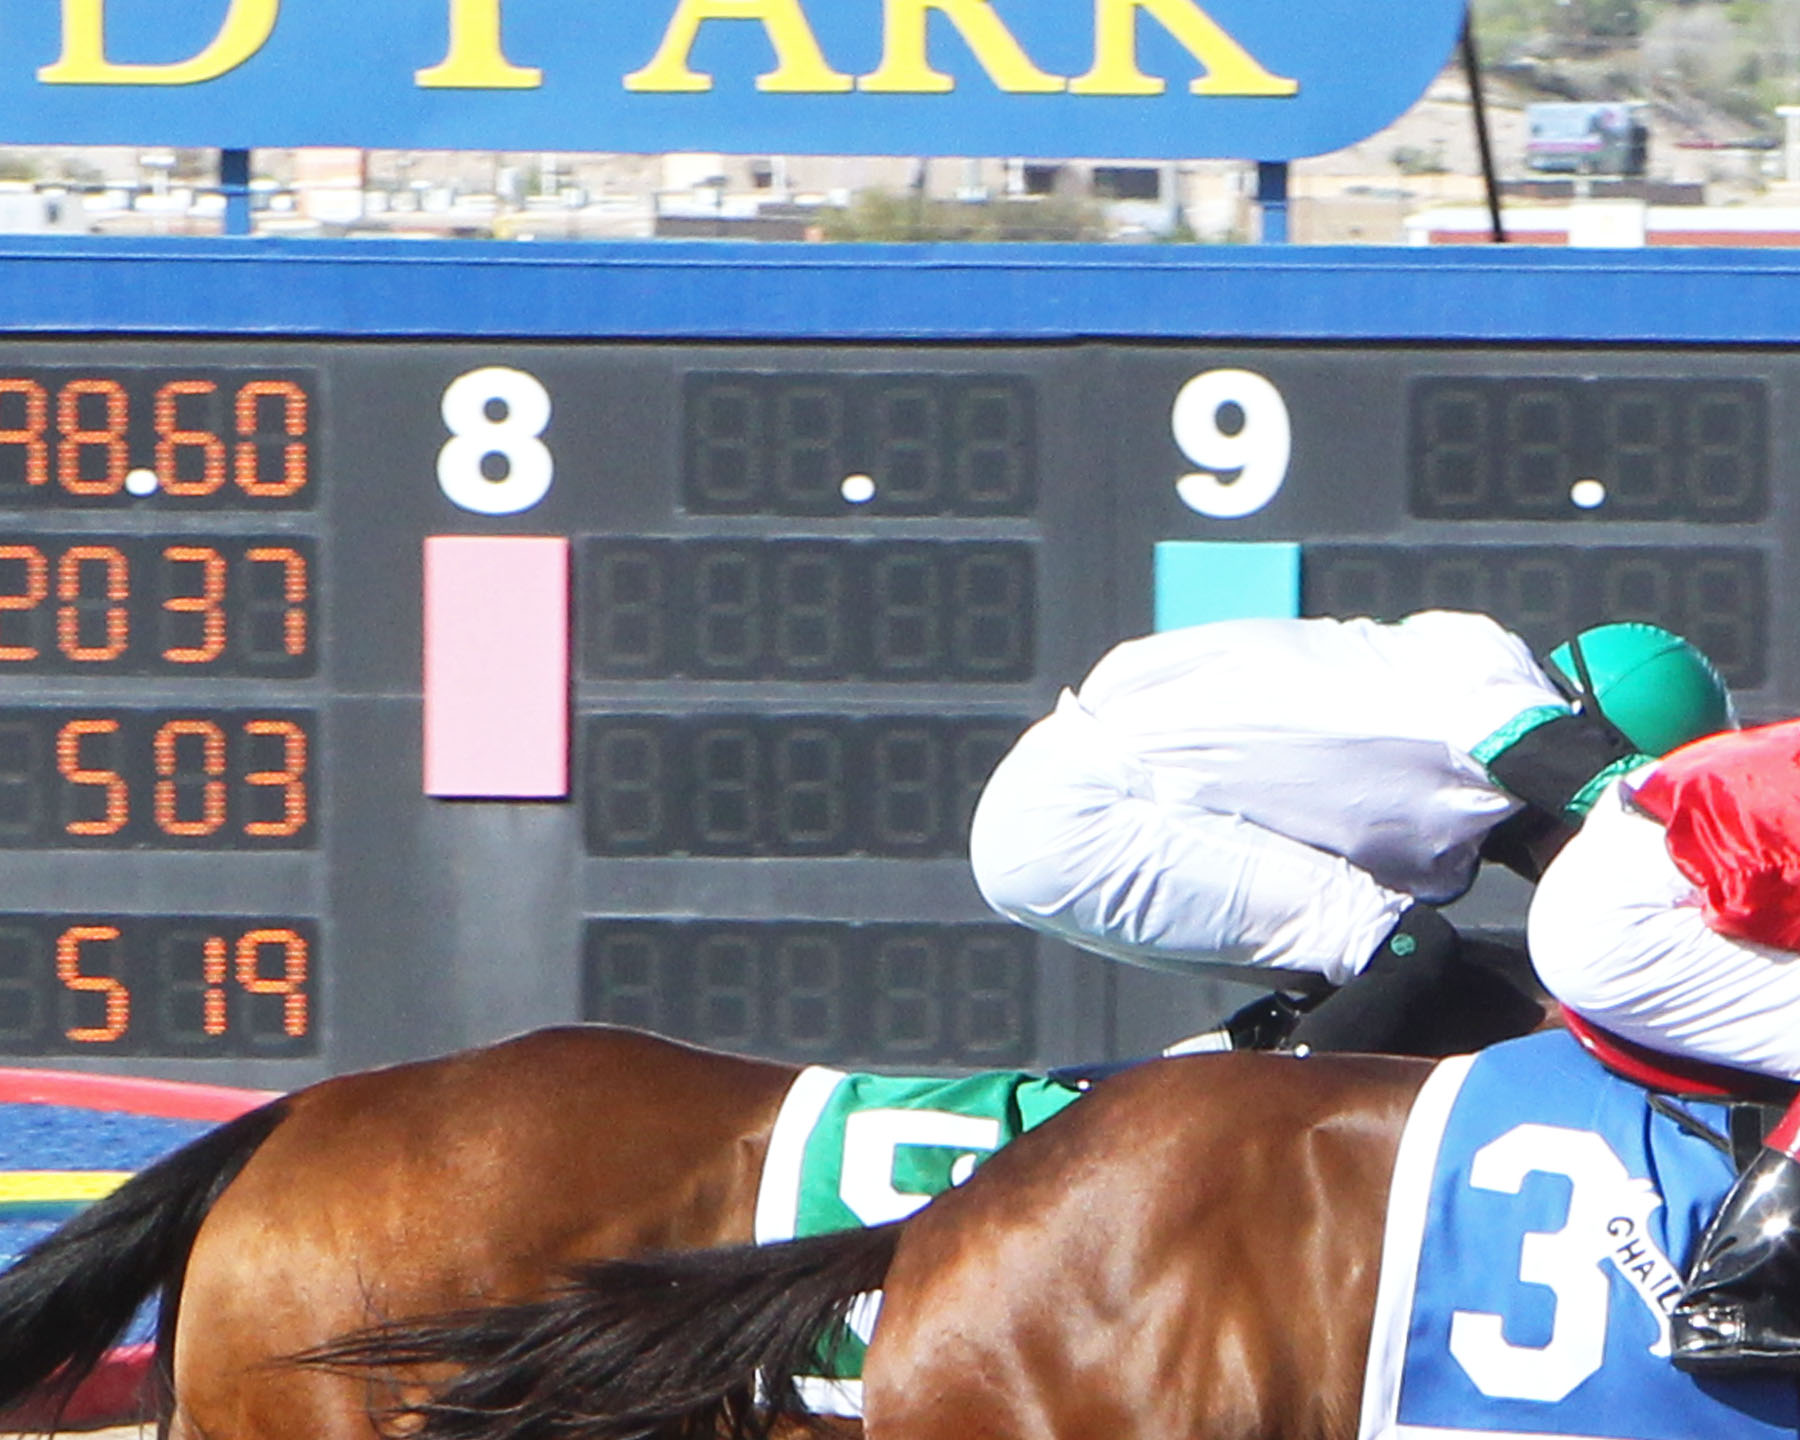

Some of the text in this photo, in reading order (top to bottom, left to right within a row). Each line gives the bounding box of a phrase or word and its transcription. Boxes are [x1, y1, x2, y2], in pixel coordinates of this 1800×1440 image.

[436, 367, 554, 516] 8
[1171, 369, 1292, 518] 9
[1449, 1122, 1630, 1403] 3
